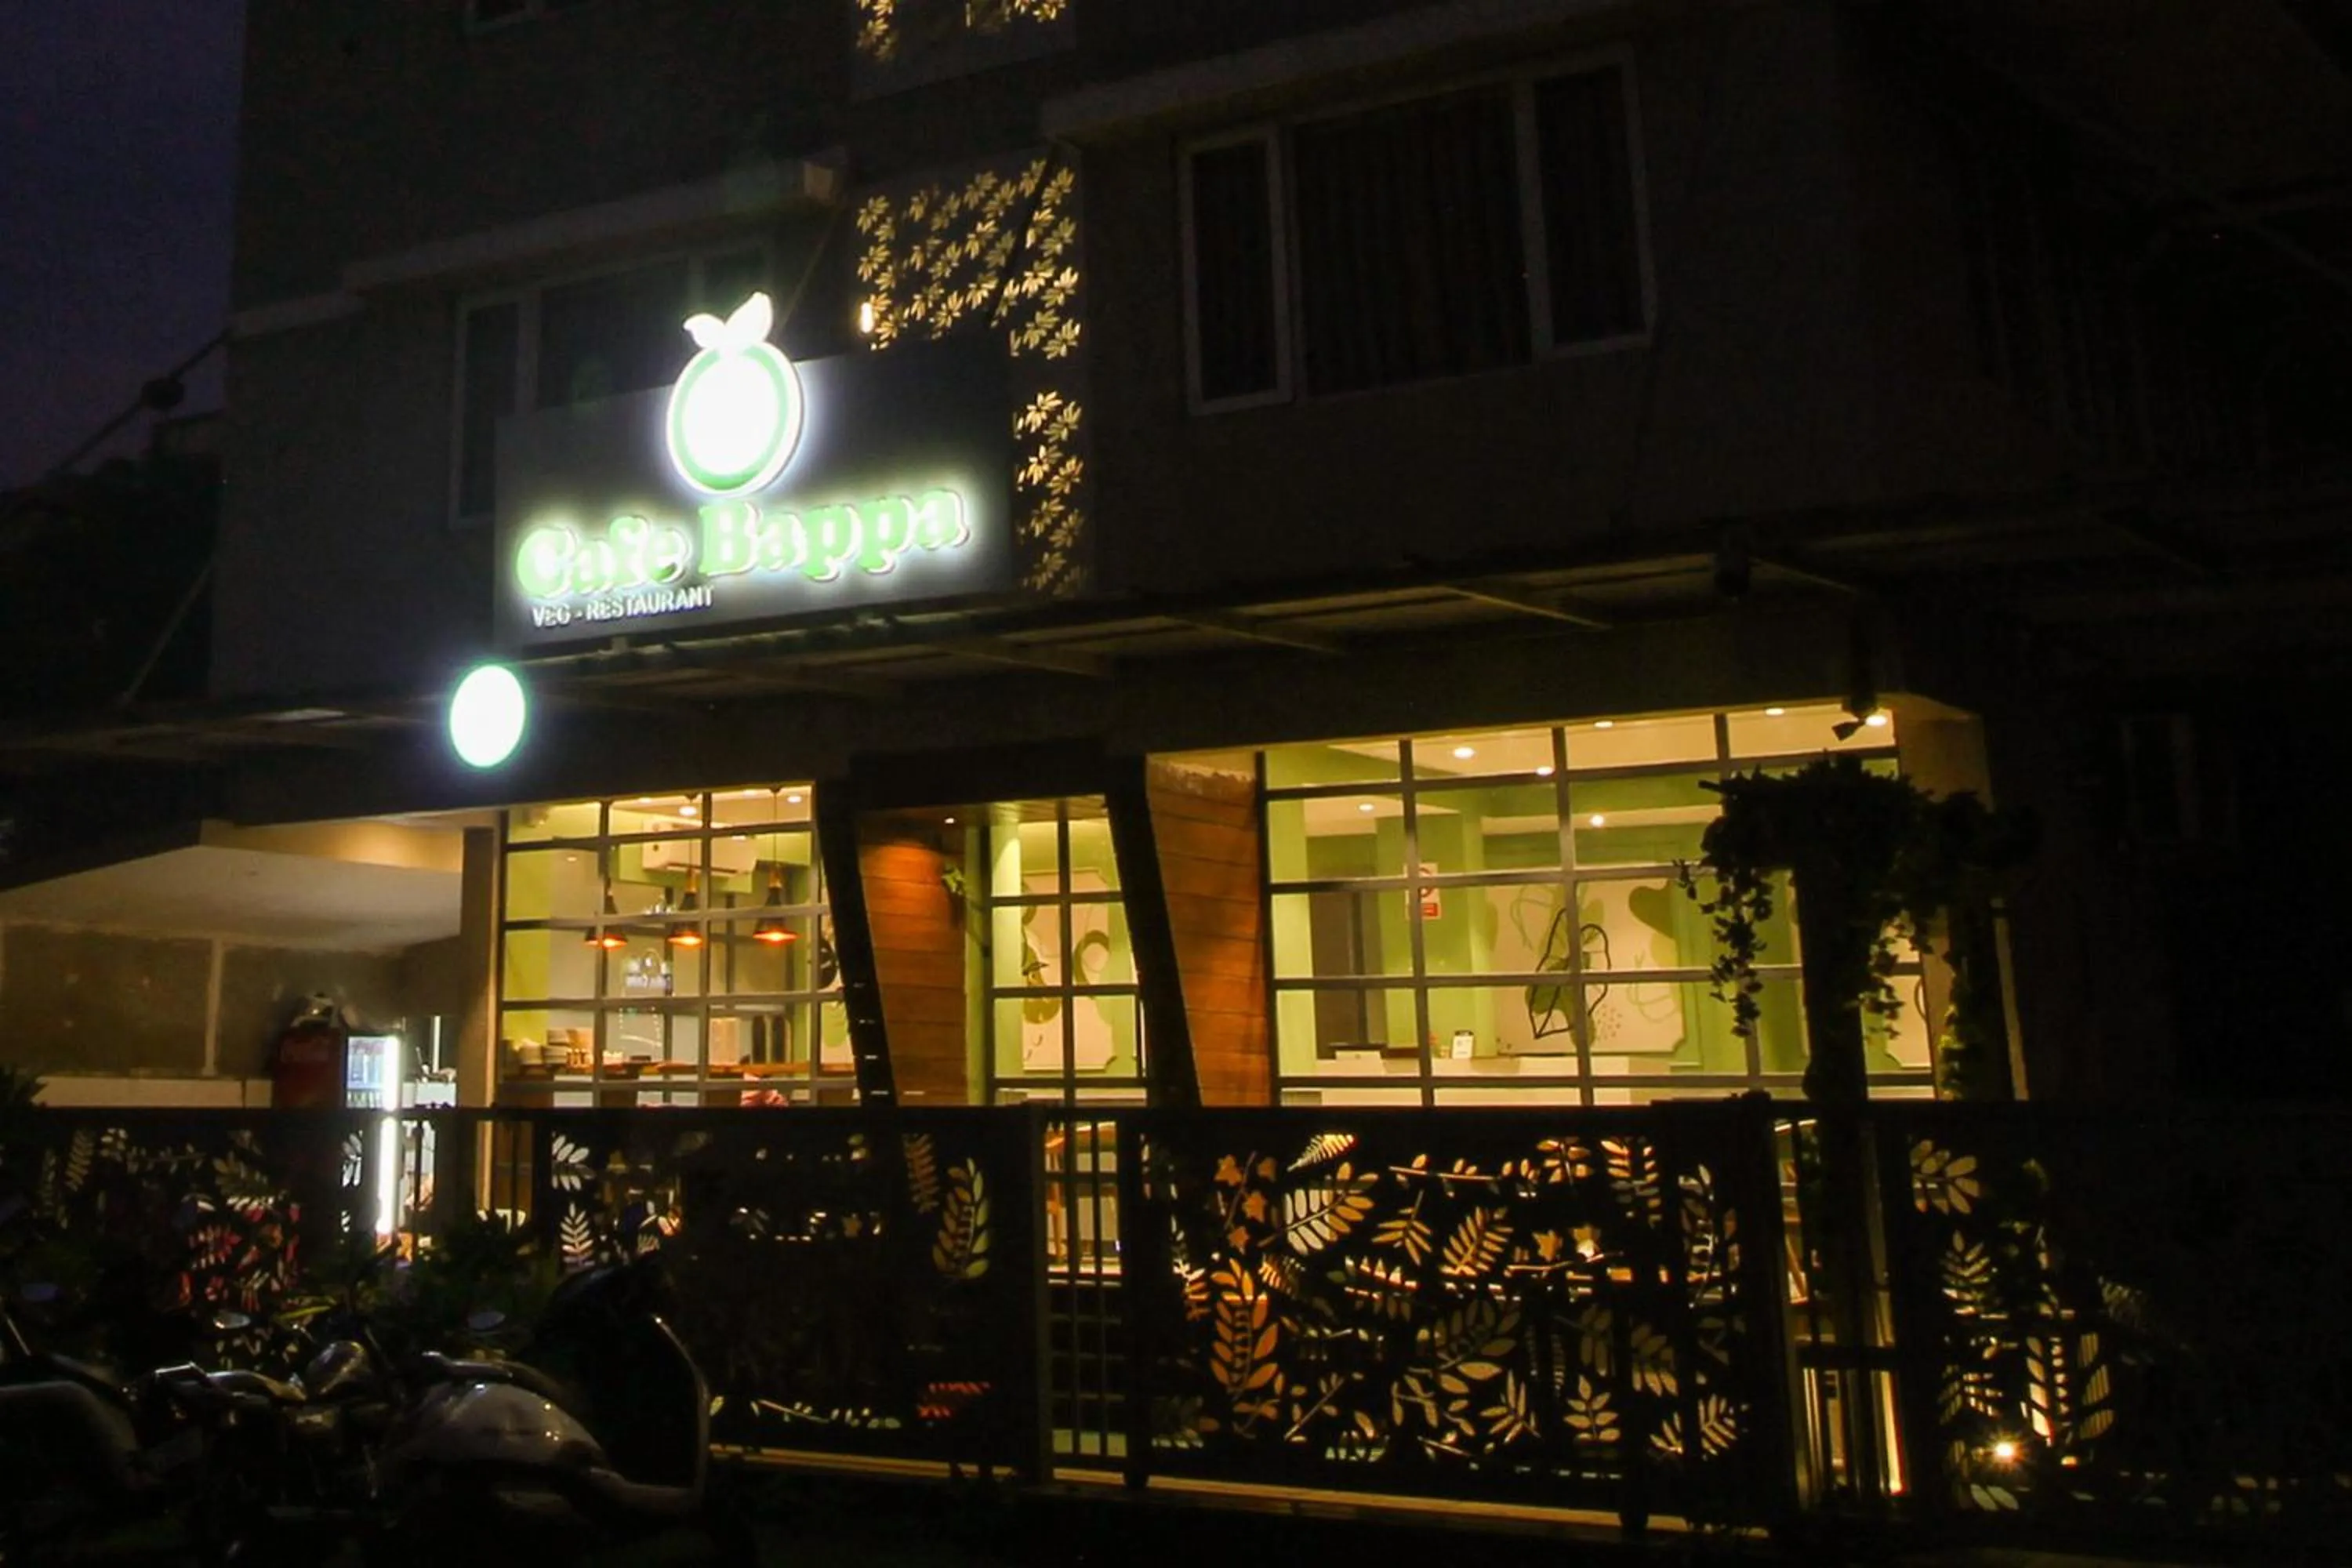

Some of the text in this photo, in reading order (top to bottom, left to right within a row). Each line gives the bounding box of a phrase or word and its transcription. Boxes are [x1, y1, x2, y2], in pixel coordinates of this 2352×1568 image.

[517, 488, 969, 599] Cafe Bappa
[532, 604, 571, 628] VEG
[586, 585, 715, 621] RESTAURANT
